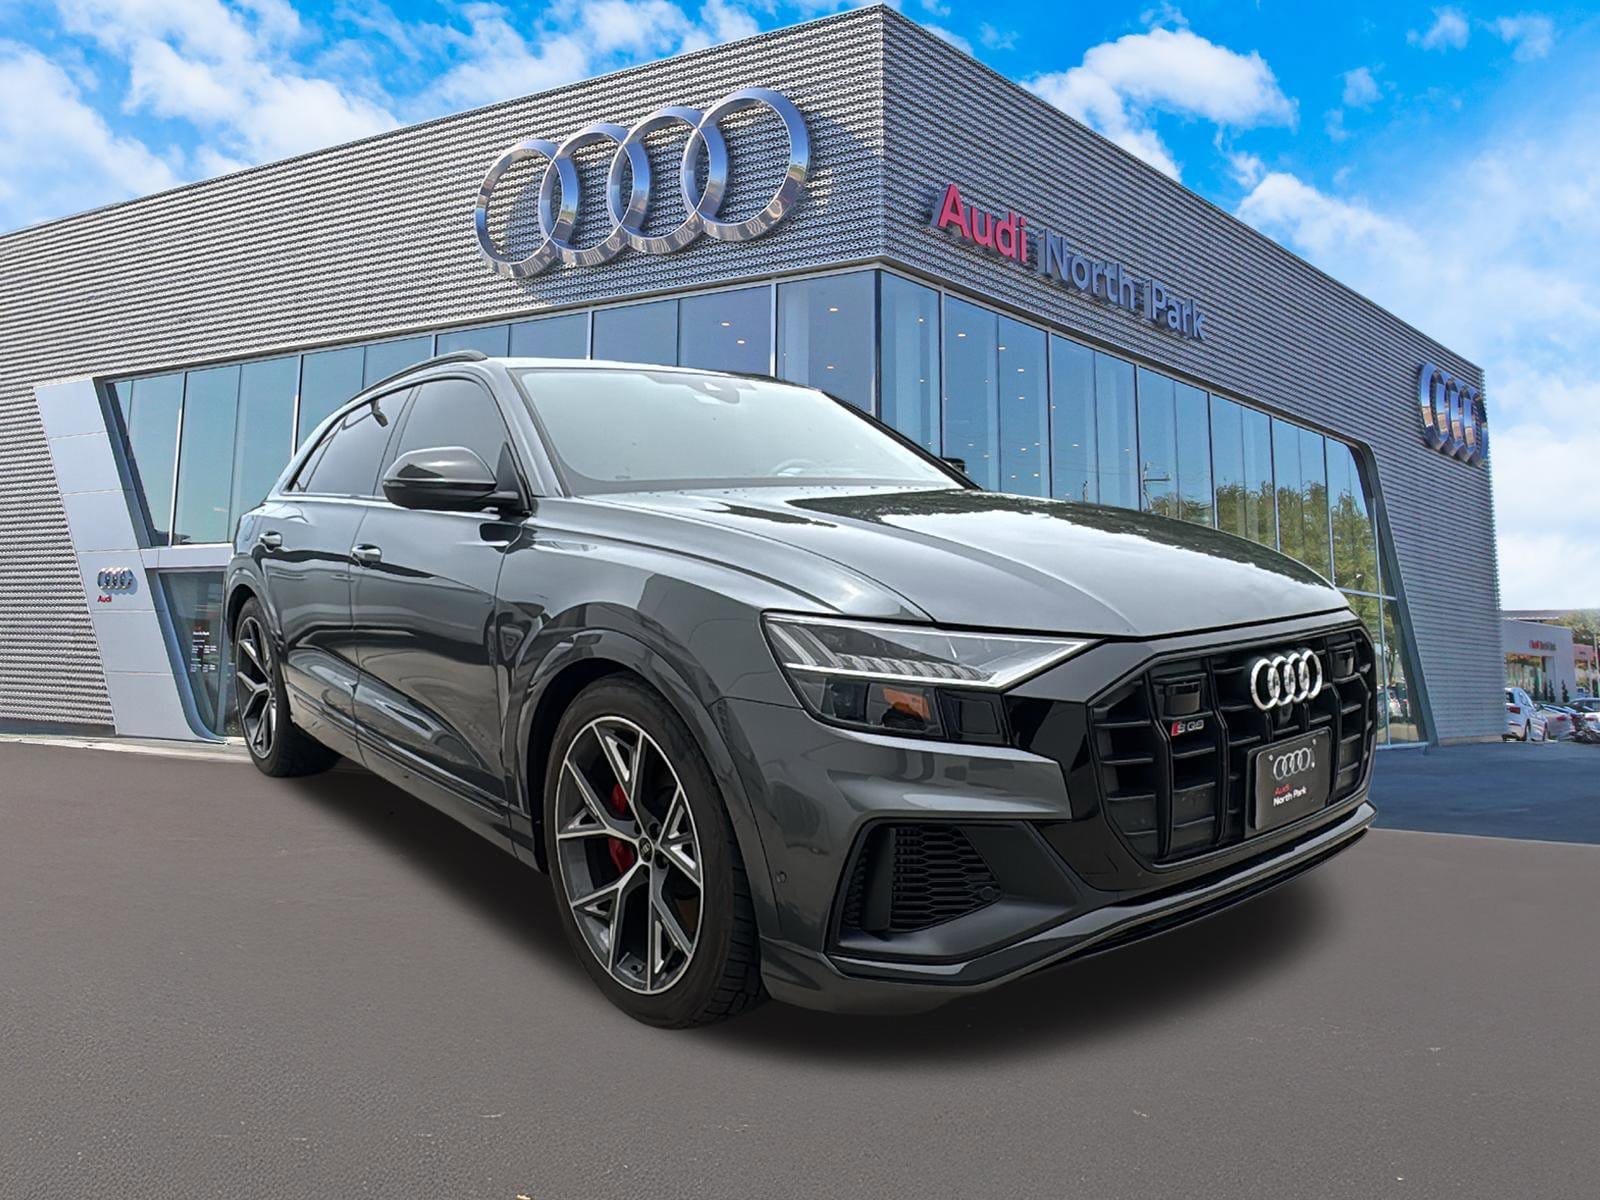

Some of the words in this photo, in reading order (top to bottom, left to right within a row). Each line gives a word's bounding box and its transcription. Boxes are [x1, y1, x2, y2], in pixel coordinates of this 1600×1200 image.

[934, 183, 1028, 263] Audi
[1040, 229, 1137, 311] North
[1146, 279, 1207, 341] Park
[1273, 793, 1293, 806] North
[1293, 786, 1307, 798] Park
[1274, 783, 1292, 795] Audi
